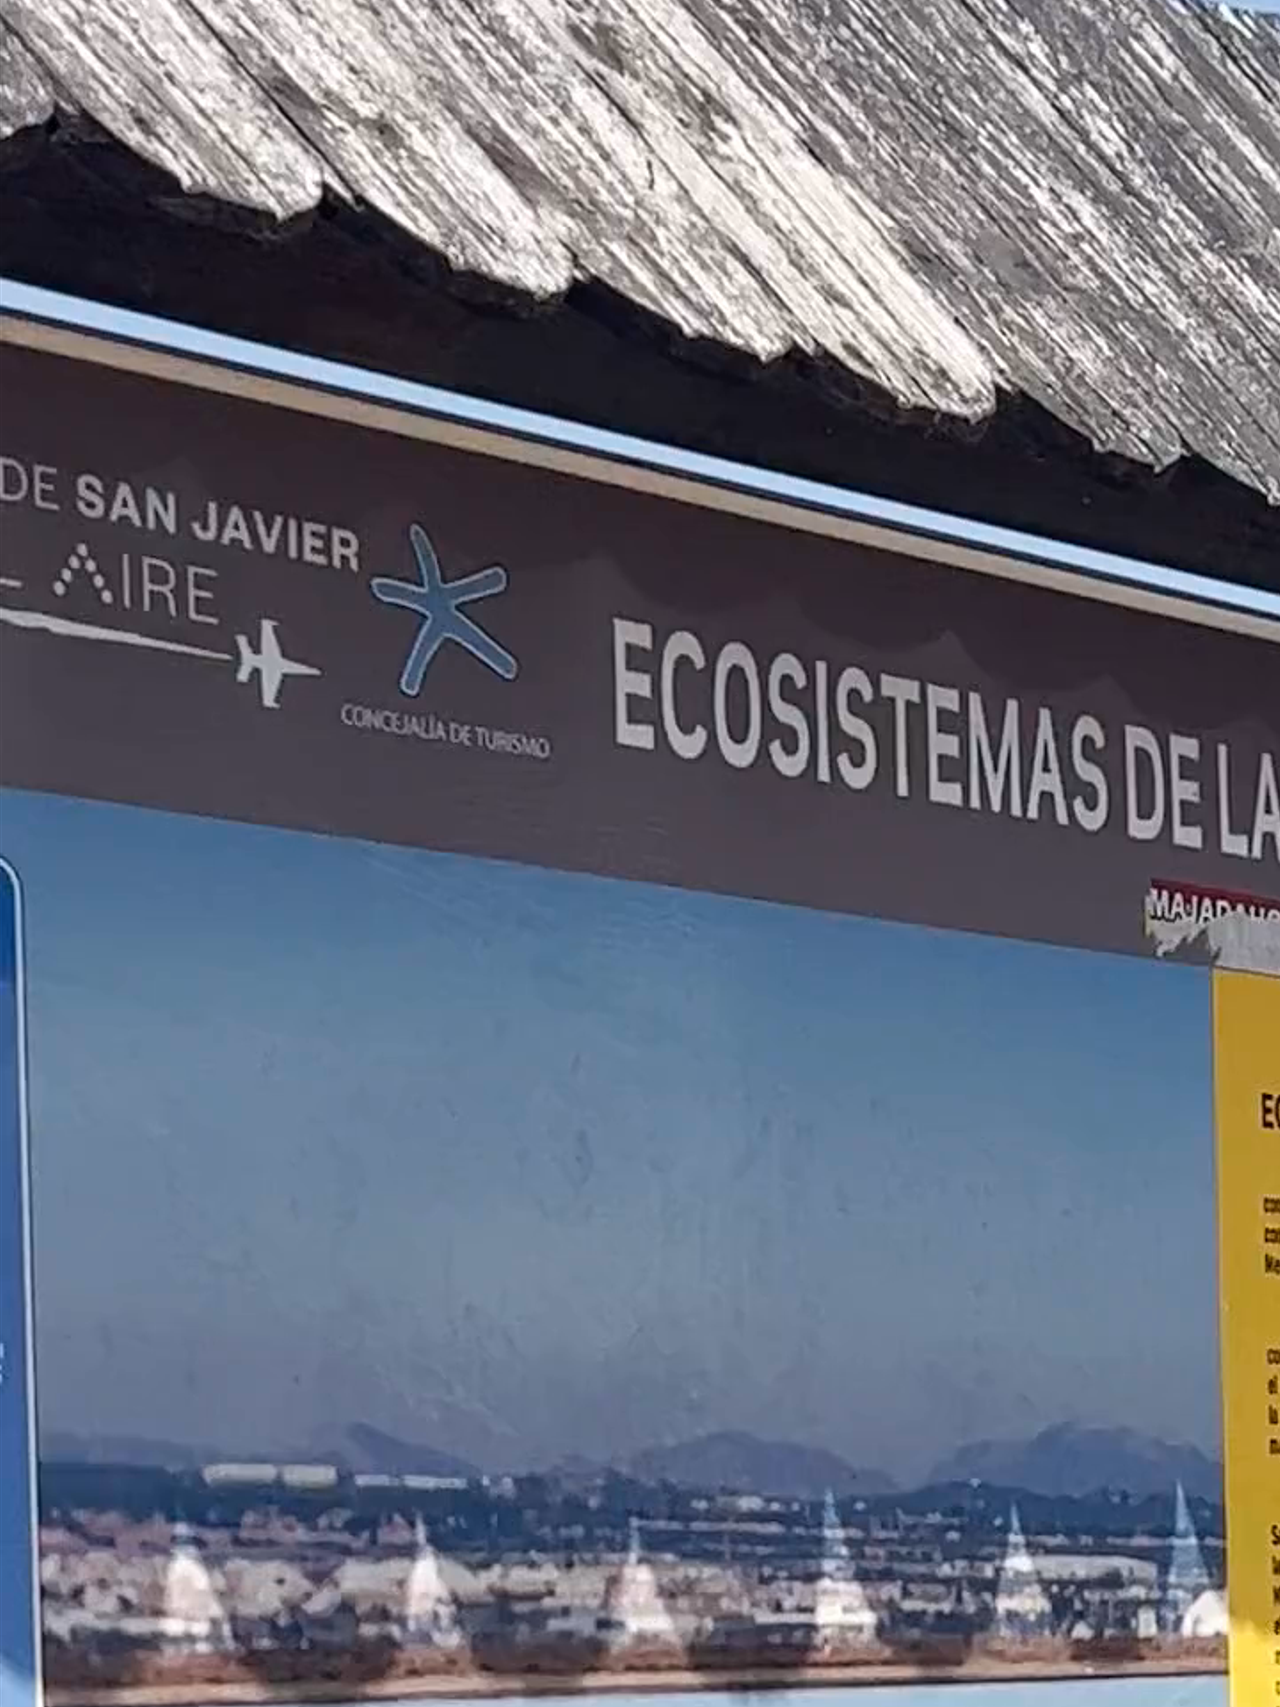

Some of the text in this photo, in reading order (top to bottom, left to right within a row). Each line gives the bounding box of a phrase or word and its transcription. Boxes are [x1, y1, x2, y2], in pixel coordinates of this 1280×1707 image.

[0, 457, 360, 573] DE SAN JAVIER
[52, 543, 219, 627] AIRE
[341, 704, 549, 758] CONCEJALÍA DE TURISMO
[613, 618, 1107, 831] ECOSISTEMAS
[1125, 725, 1202, 848] DE
